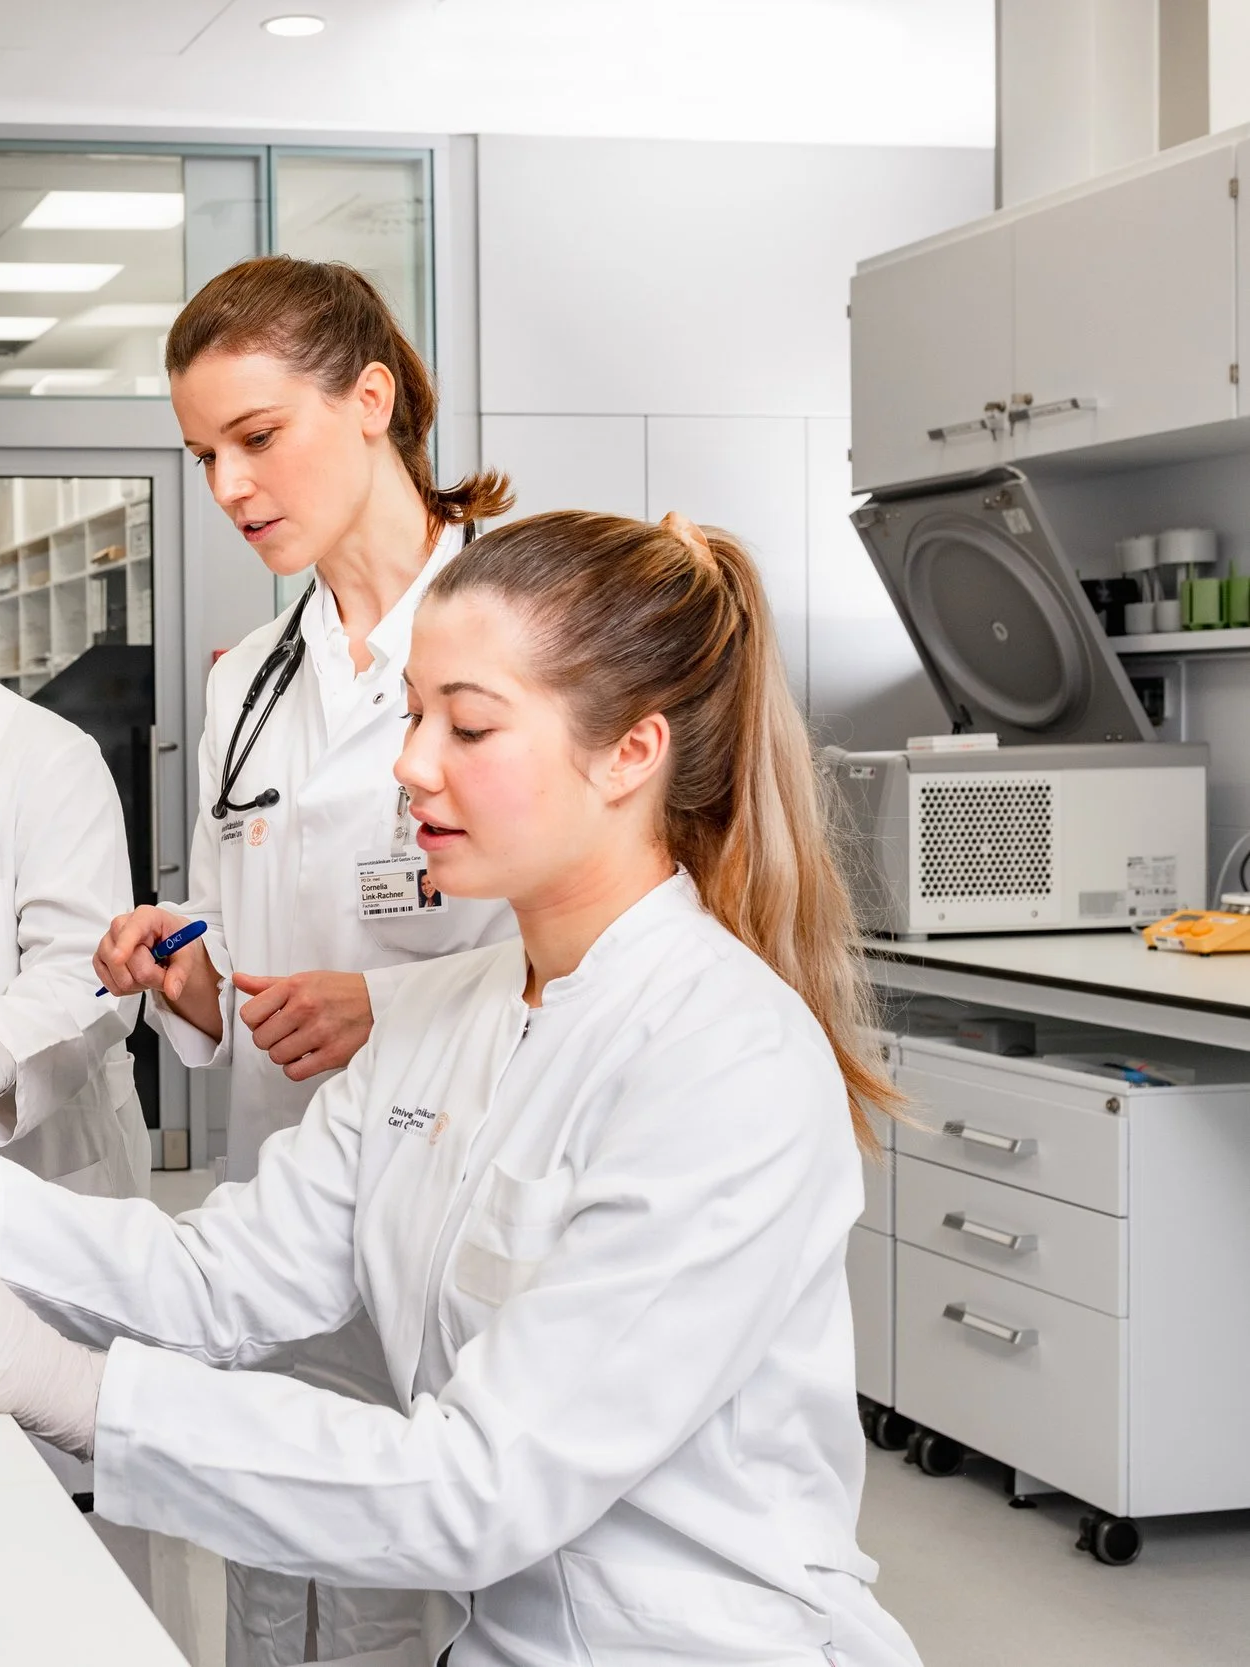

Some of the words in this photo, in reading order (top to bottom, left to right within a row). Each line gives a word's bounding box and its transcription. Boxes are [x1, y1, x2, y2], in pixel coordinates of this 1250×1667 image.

[361, 883, 388, 892] Cornelia
[362, 891, 404, 901] Link-Rachner
[388, 1116, 404, 1128] Carl
